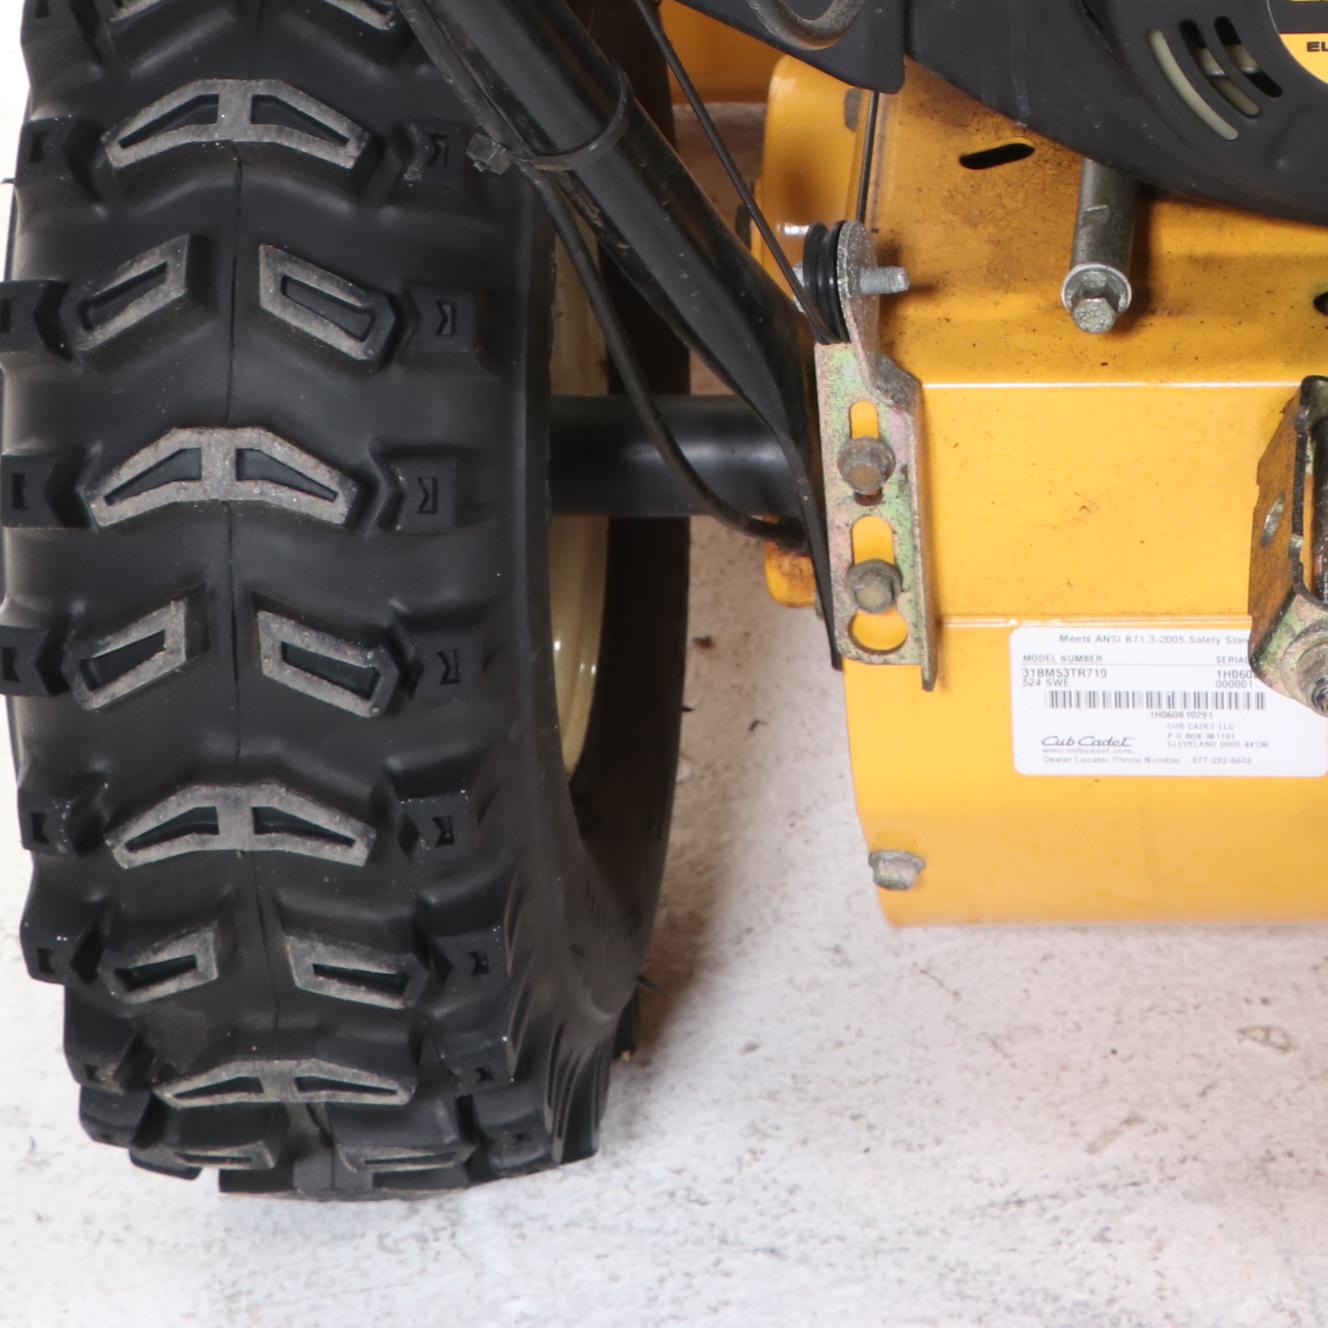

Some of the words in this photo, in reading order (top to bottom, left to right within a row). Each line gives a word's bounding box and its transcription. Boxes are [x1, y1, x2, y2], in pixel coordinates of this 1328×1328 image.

[1059, 635, 1092, 644] Meets
[1096, 635, 1121, 644] ANSI
[1188, 635, 1221, 646] Safety
[1226, 636, 1250, 645] Stan
[1023, 654, 1057, 663] MODEL
[1060, 654, 1103, 663] NUMBER
[1022, 678, 1042, 687] 524
[1046, 678, 1069, 687] SWE
[1041, 735, 1075, 747] Cub
[1077, 735, 1136, 747] Cadet
